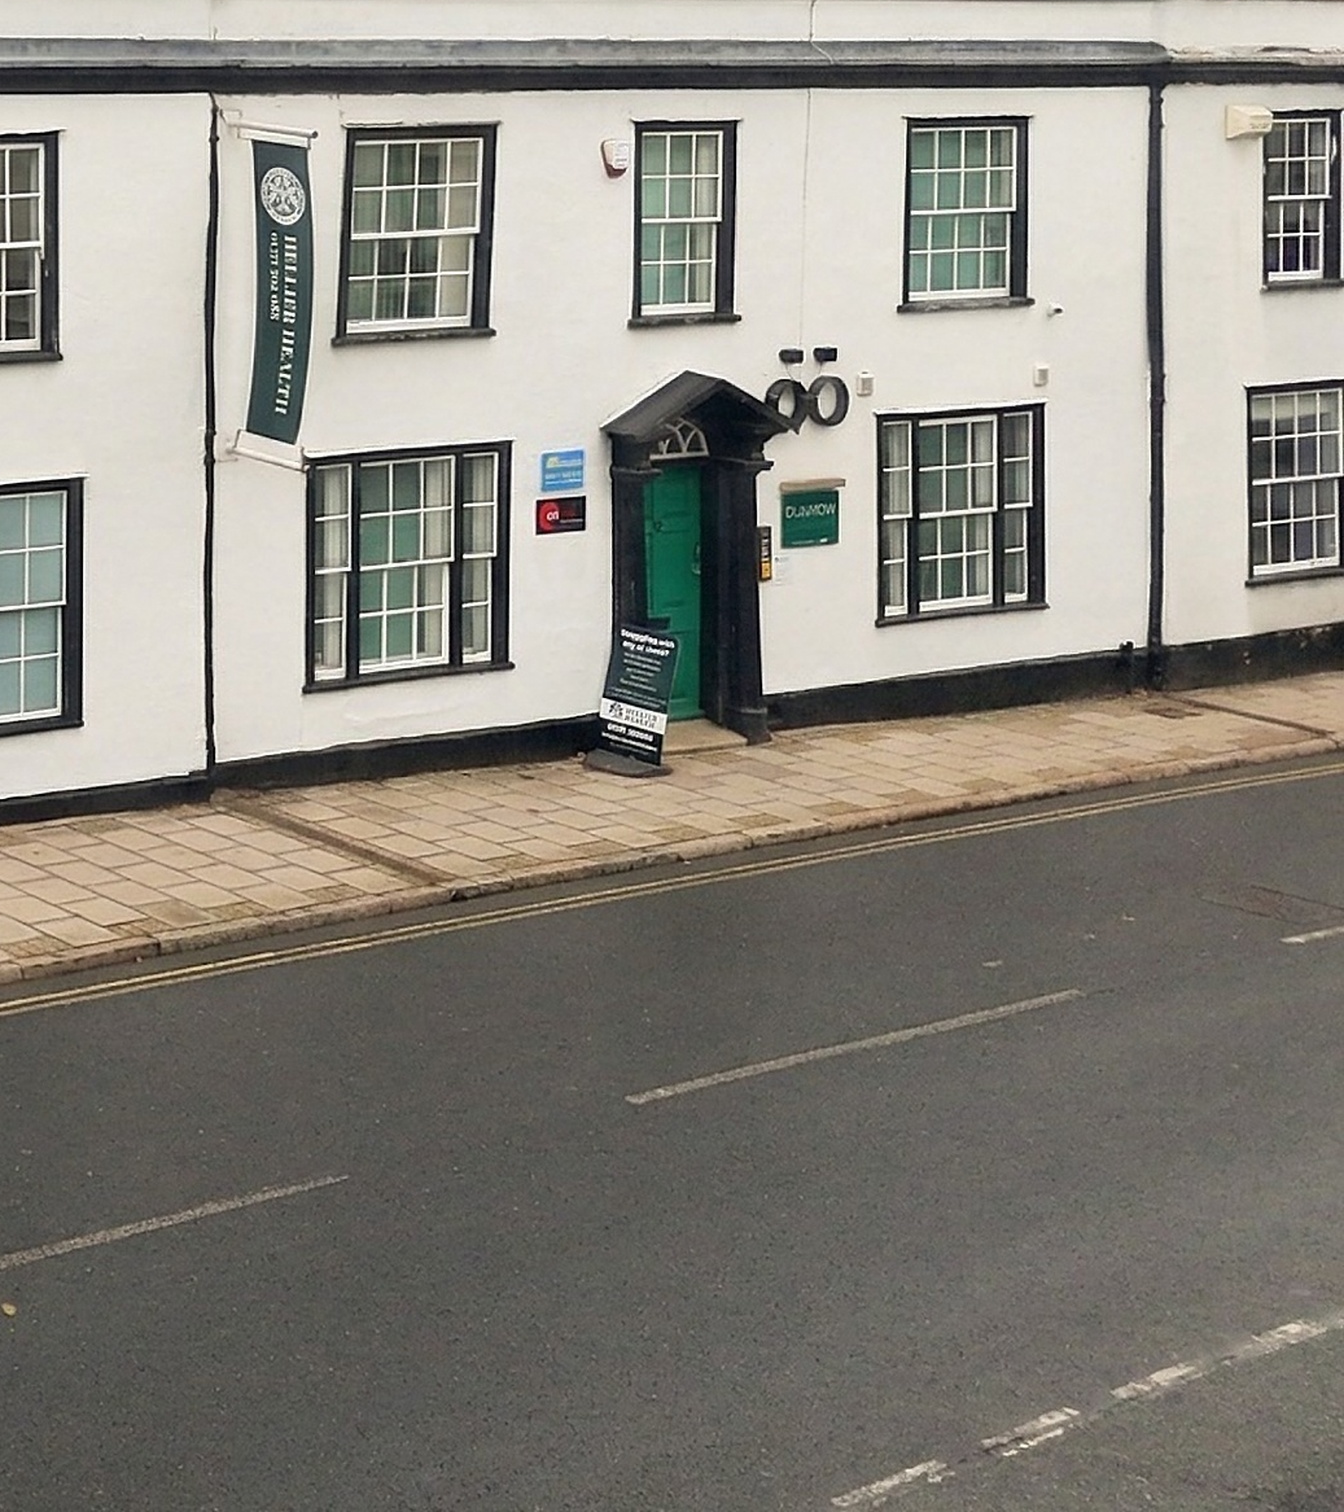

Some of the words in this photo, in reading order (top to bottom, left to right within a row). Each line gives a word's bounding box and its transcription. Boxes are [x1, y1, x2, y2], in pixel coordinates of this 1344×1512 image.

[283, 235, 297, 324] HELLIER
[275, 329, 295, 415] HEALTH
[785, 503, 836, 519] DUNMOW
